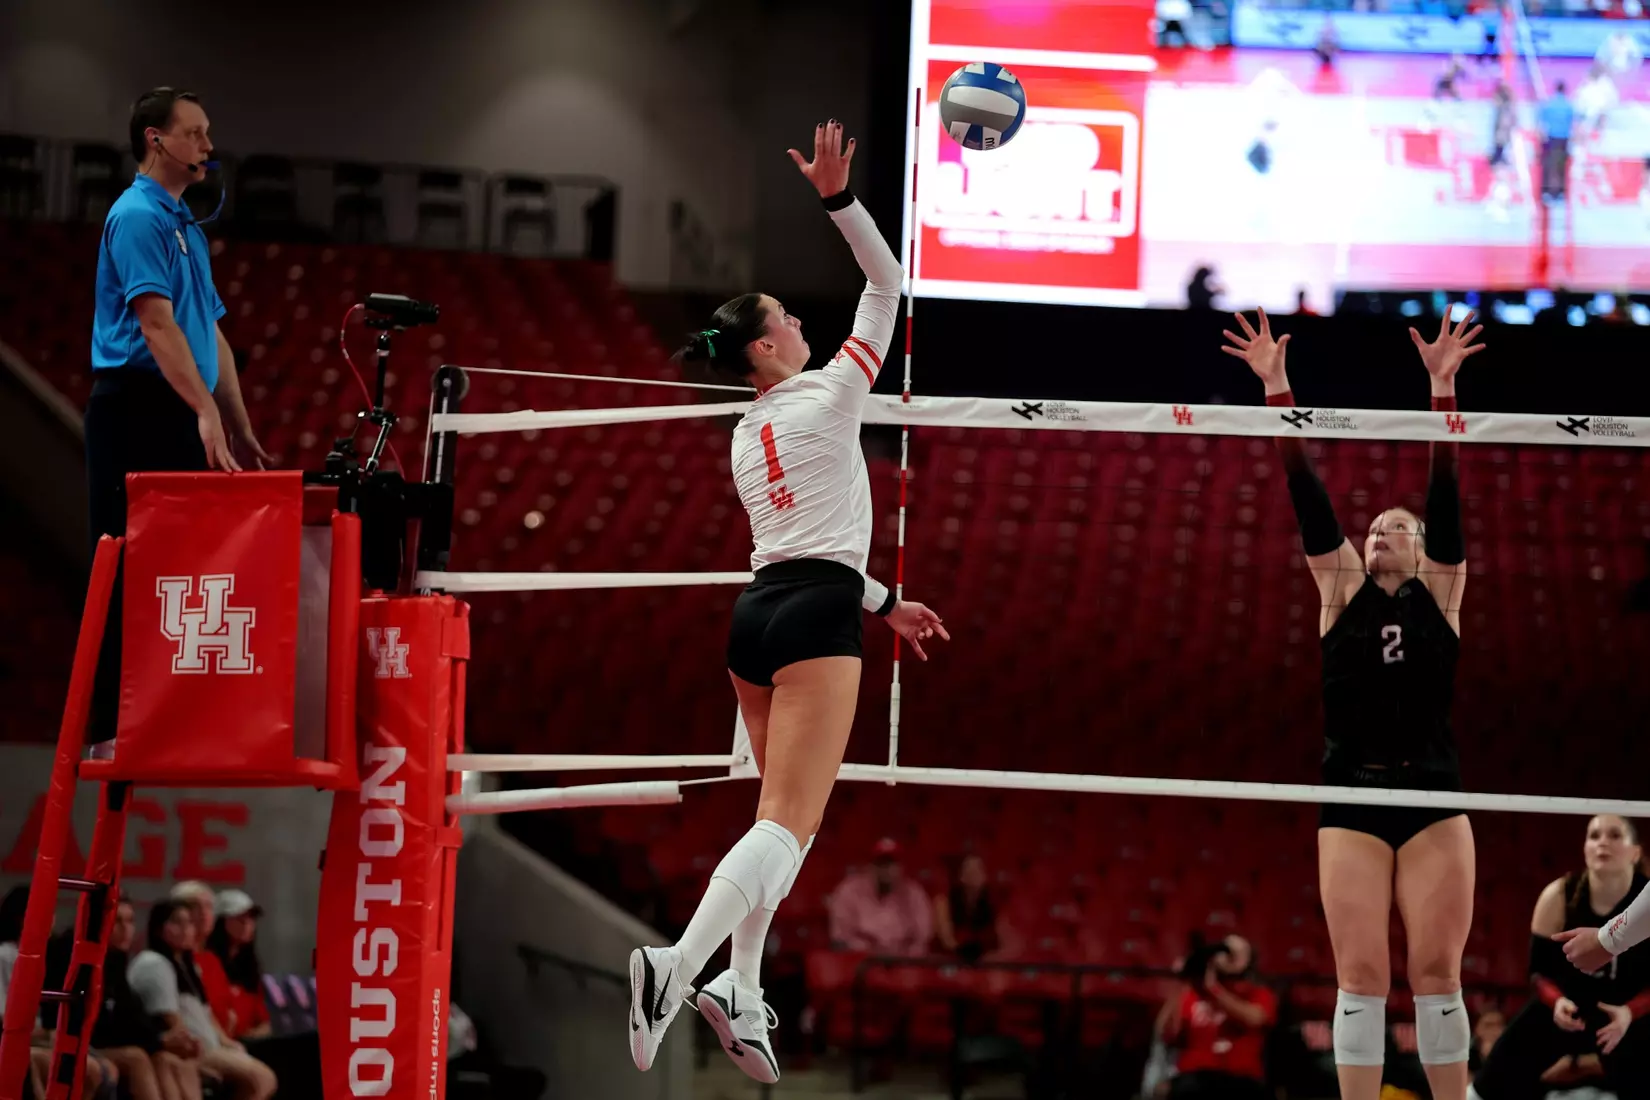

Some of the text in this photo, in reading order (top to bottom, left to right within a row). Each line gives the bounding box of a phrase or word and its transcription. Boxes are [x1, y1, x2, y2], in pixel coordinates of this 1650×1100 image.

[1172, 405, 1193, 425] UH
[1445, 413, 1467, 434] UH
[1592, 430, 1635, 438] VOLLEYBALL
[760, 421, 784, 484] 1
[767, 484, 795, 511] UH
[156, 573, 256, 675] UH
[1381, 624, 1406, 665] 2
[366, 627, 410, 678] UH
[430, 987, 440, 1057] sports
